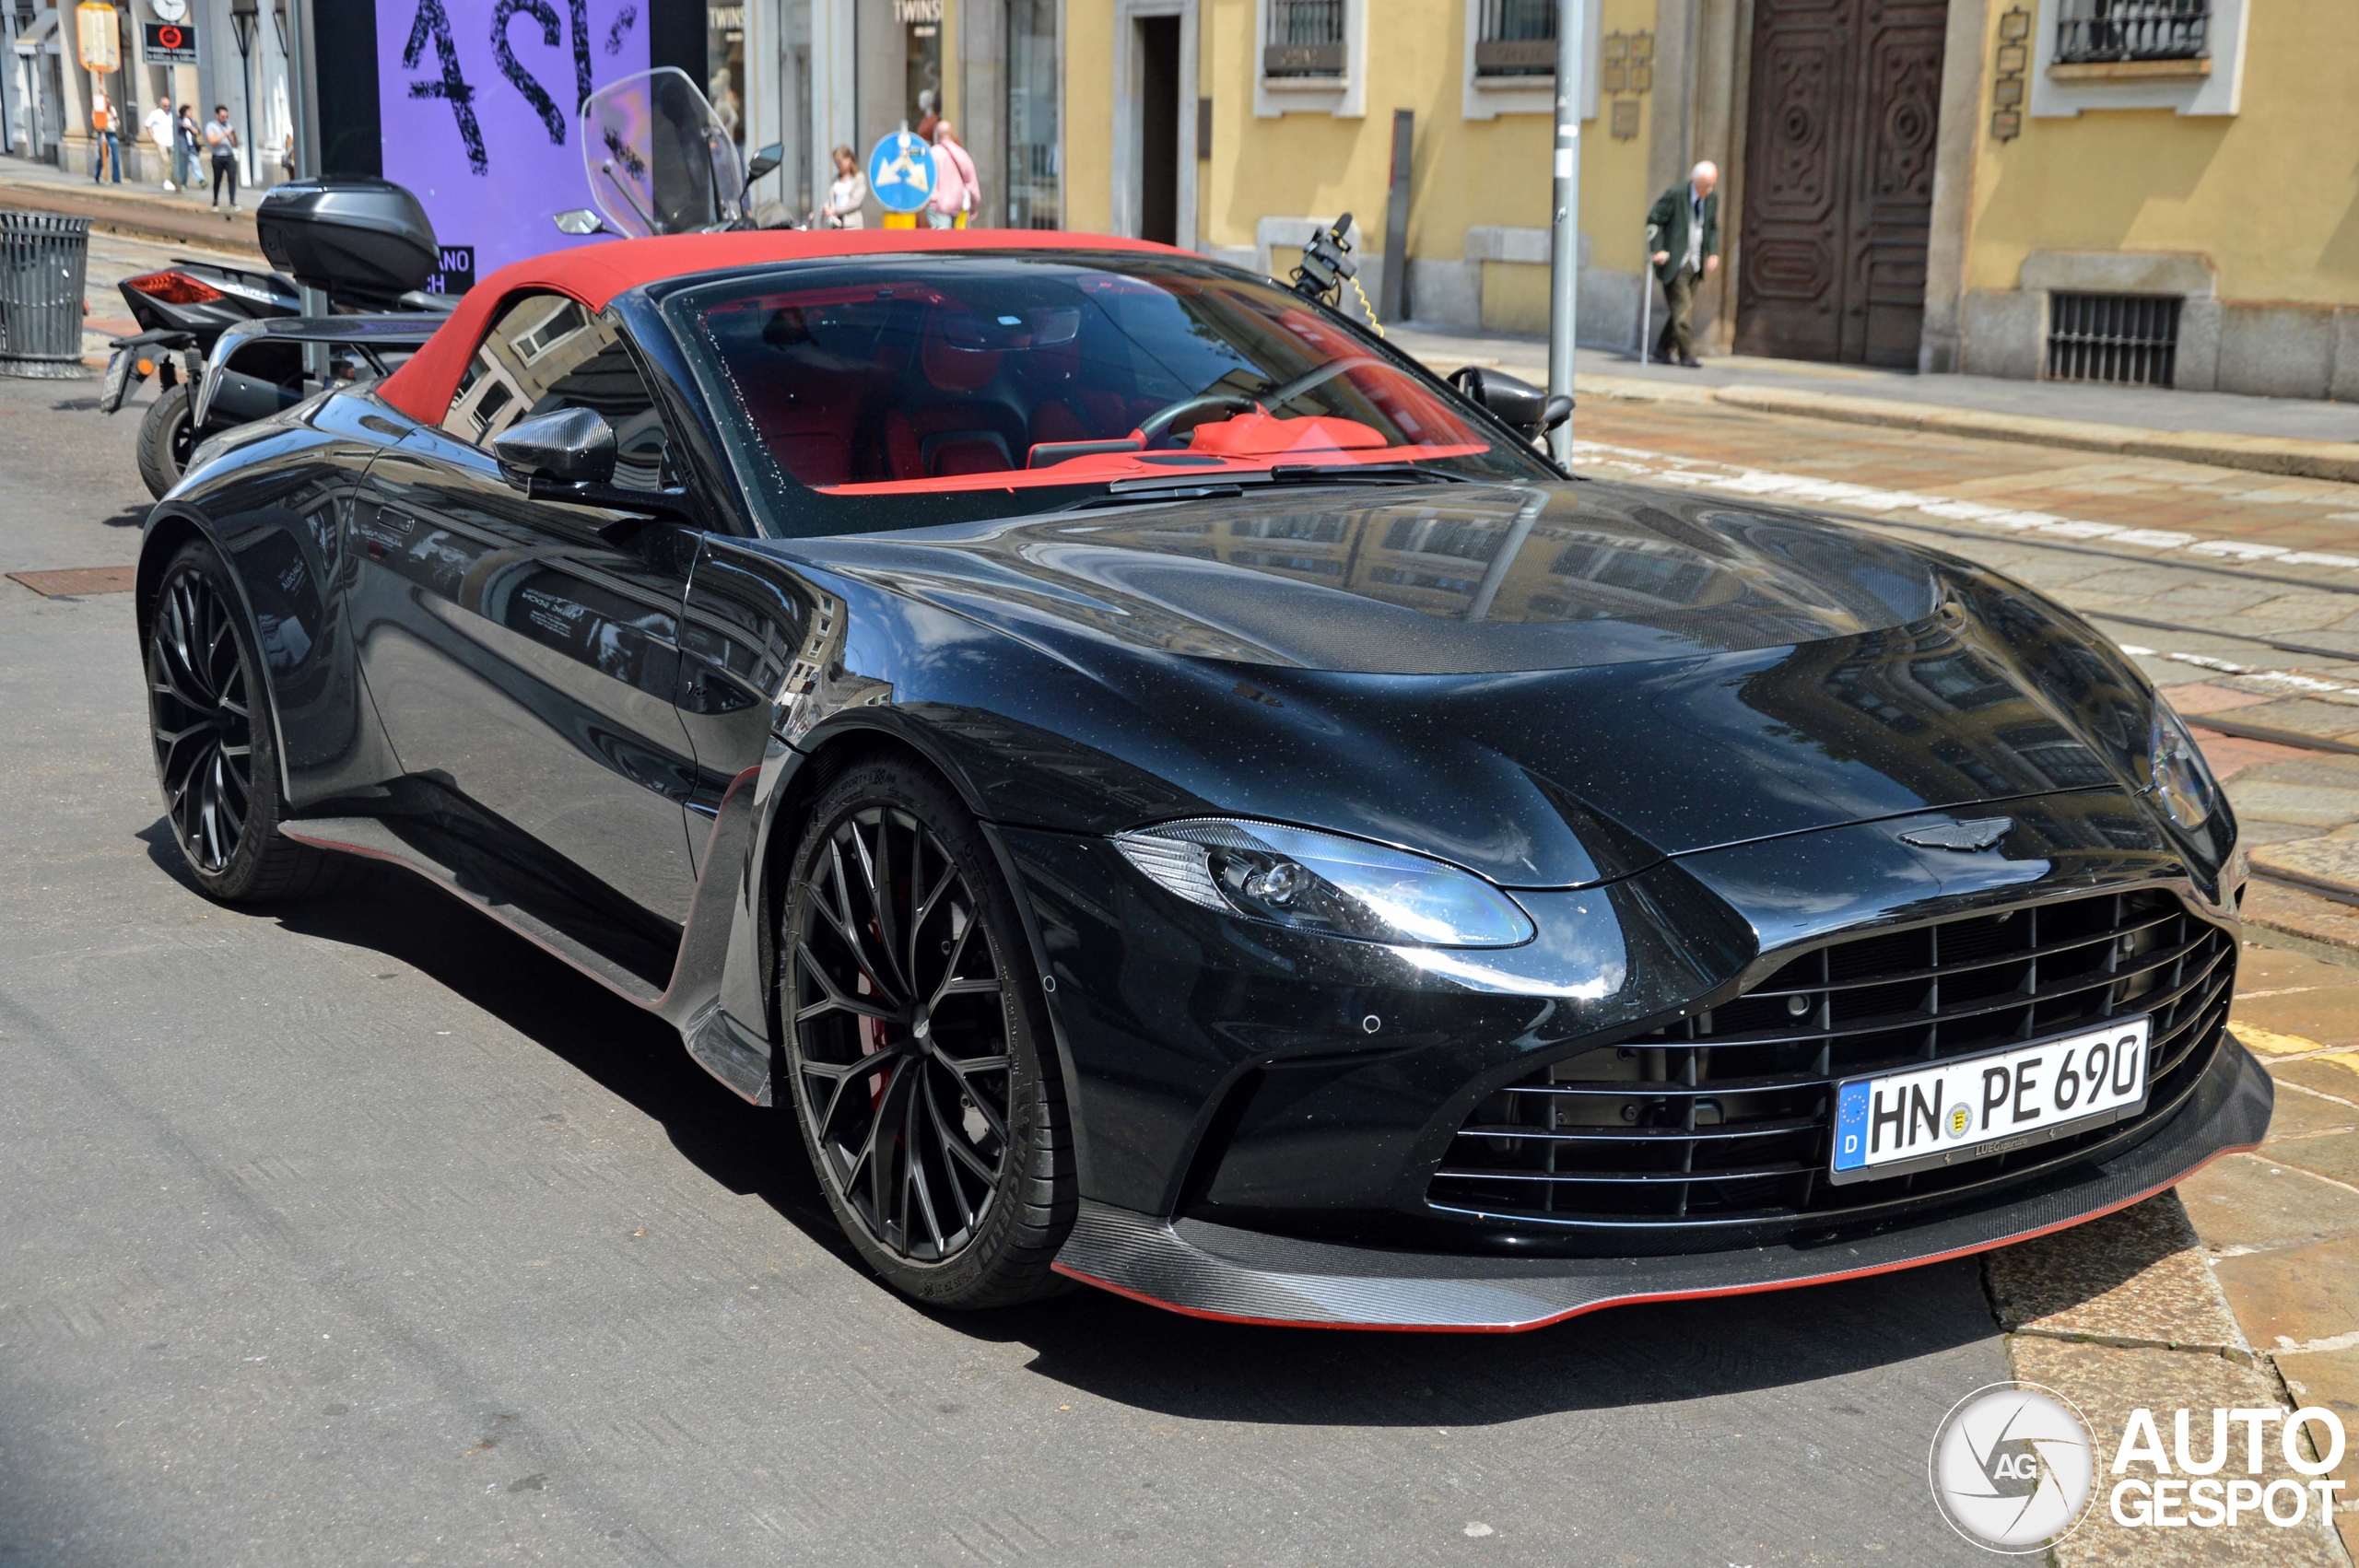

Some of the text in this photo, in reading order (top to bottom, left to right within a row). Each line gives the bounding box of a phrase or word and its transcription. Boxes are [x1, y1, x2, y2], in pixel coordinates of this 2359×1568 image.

[1844, 1134, 1858, 1154] D
[1871, 1078, 1943, 1153] HN
[1981, 1058, 2042, 1130] PE
[2054, 1035, 2139, 1111] 690
[980, 1134, 1028, 1266] MICHELIN
